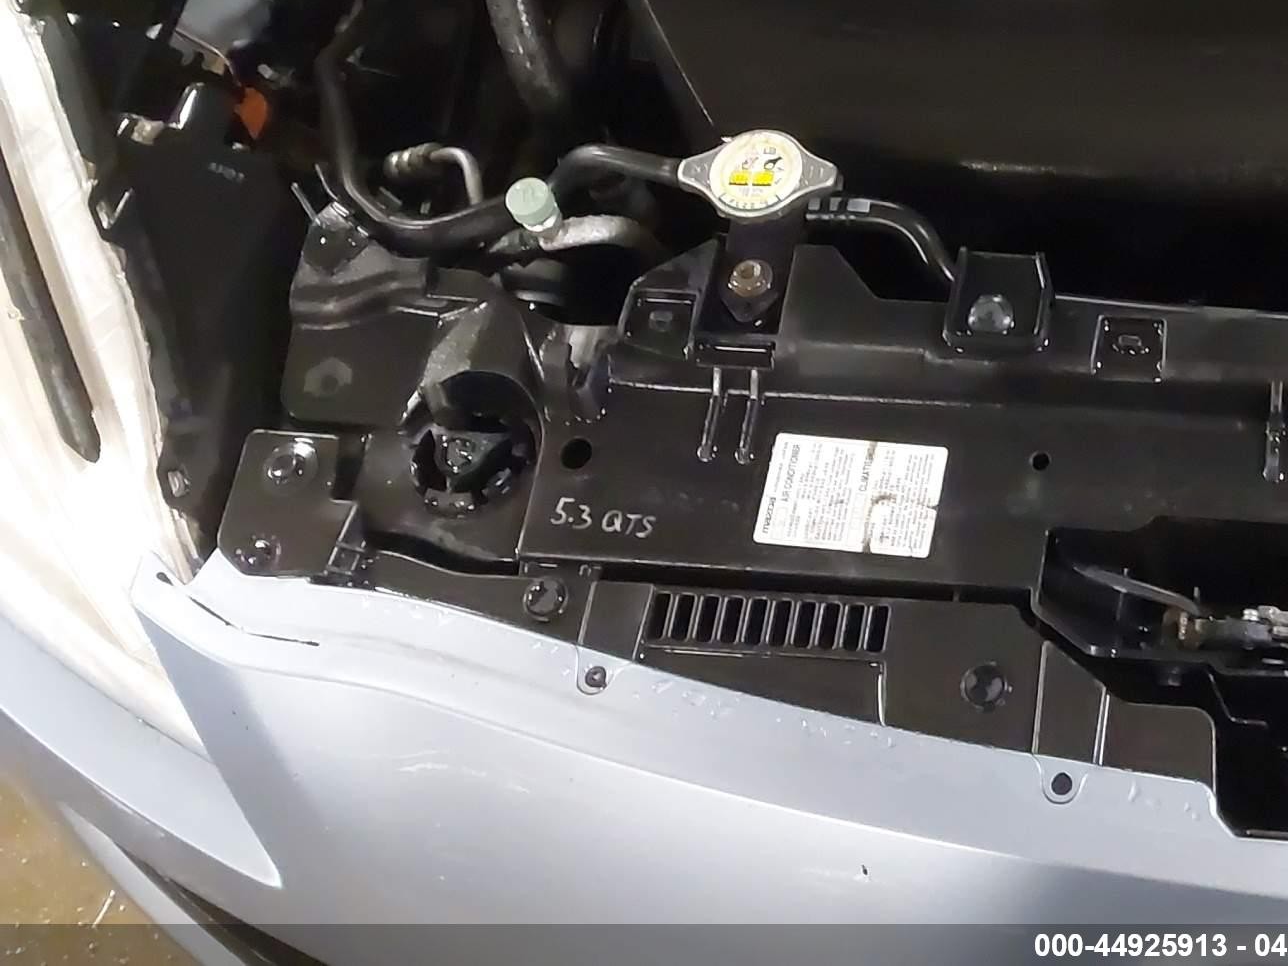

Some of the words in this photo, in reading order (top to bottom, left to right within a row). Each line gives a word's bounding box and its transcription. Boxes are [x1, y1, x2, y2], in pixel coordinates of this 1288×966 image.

[550, 497, 593, 530] 5.3
[601, 509, 657, 538] QTS
[762, 497, 777, 534] mazda
